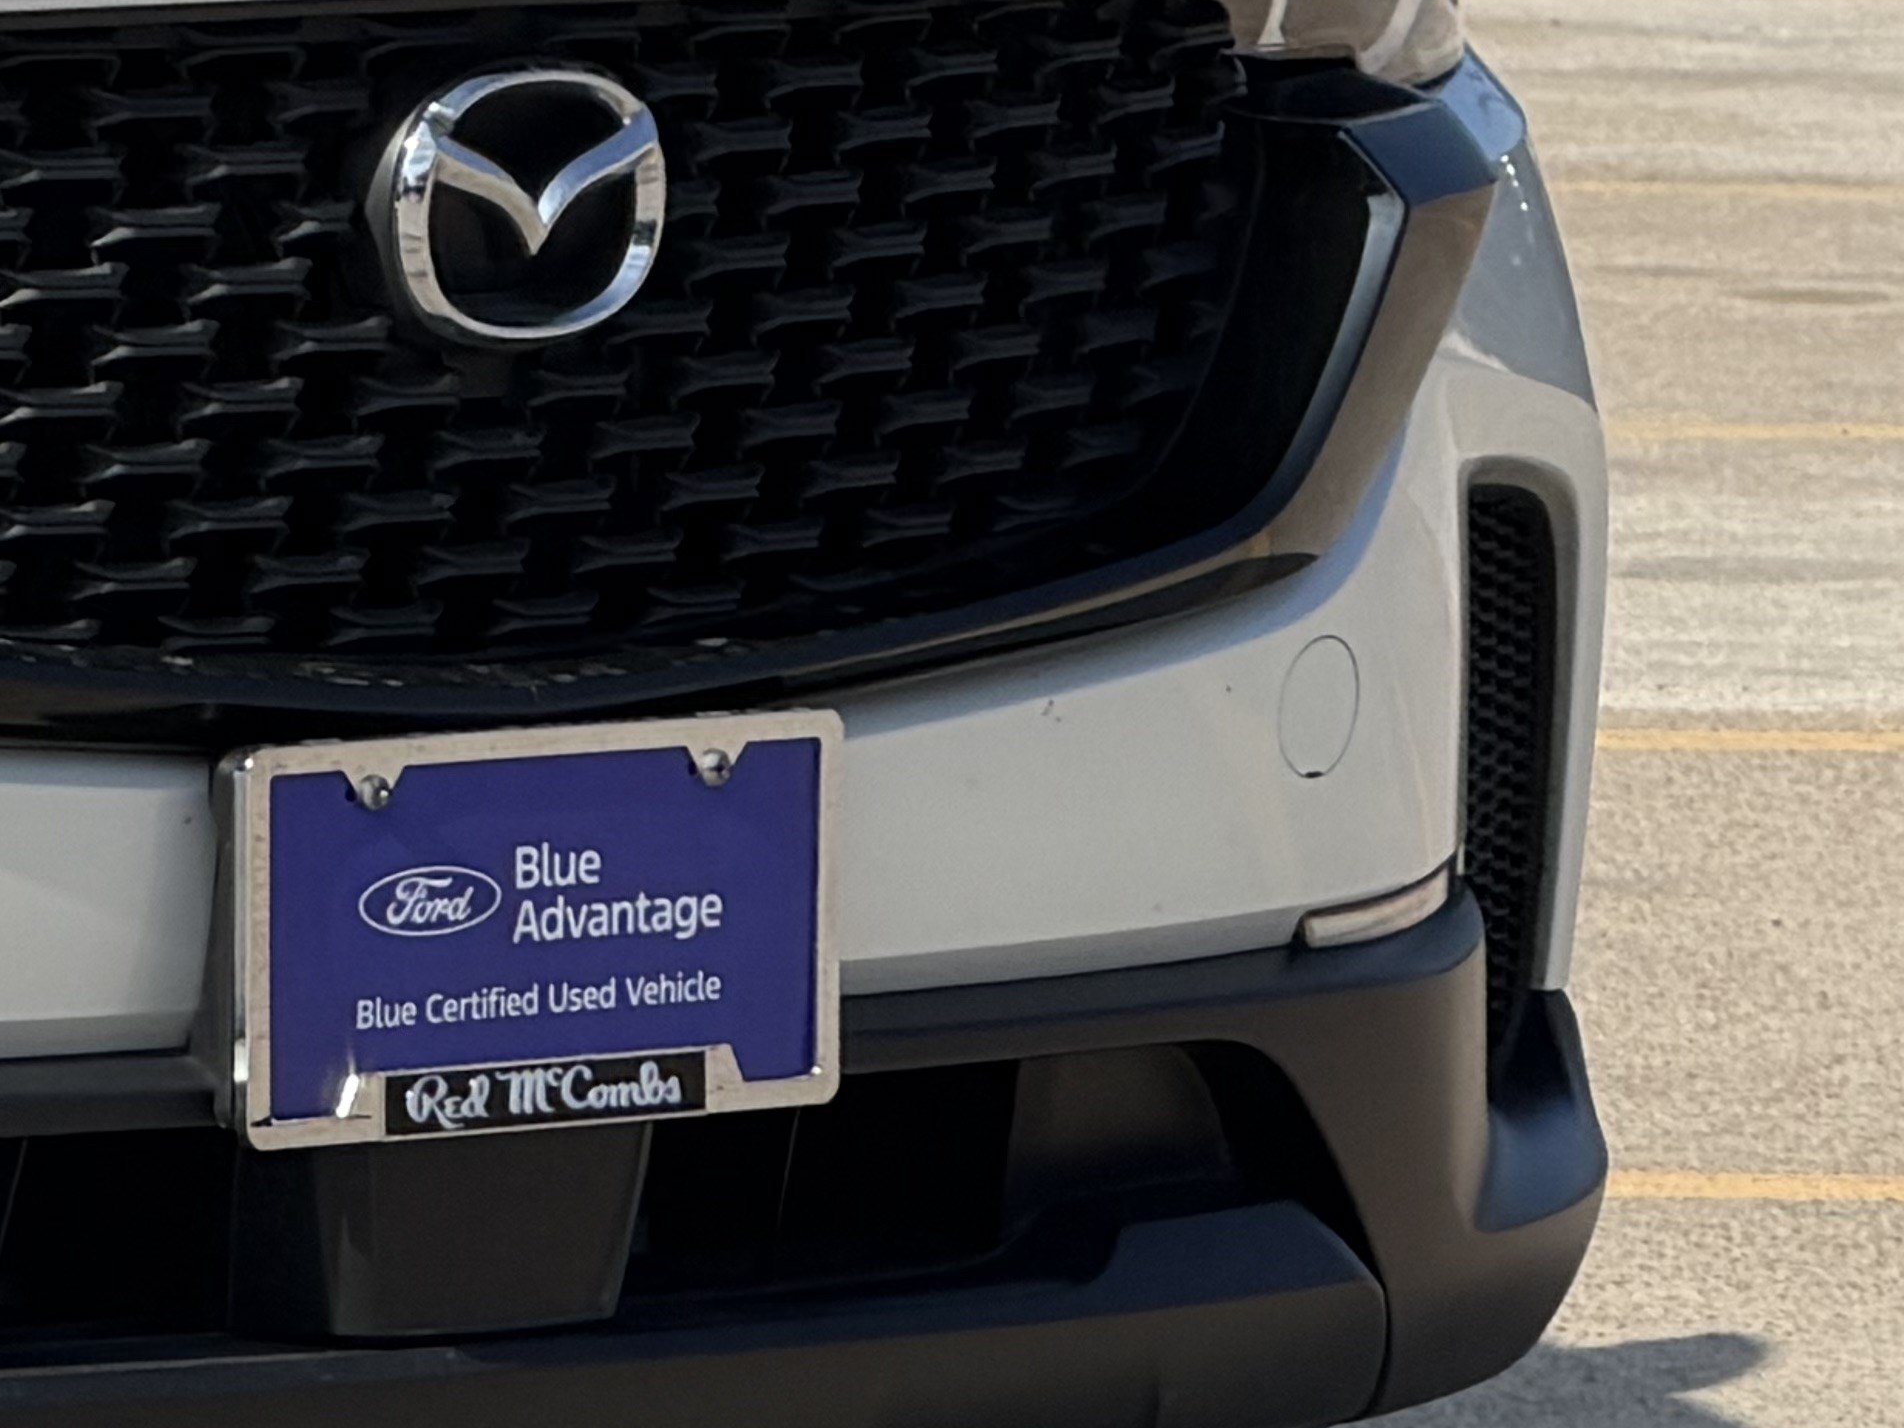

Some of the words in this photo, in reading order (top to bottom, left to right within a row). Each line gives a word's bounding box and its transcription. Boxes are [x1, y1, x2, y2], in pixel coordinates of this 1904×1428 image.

[515, 842, 602, 890] Blue
[386, 876, 474, 926] Ford
[512, 891, 723, 945] Advantage
[355, 996, 418, 1031] Blue
[425, 982, 540, 1025] Certified
[548, 976, 617, 1014] Used
[625, 969, 723, 1007] Vehicle
[405, 1073, 491, 1130] Red
[495, 1060, 683, 1115] McCombs
